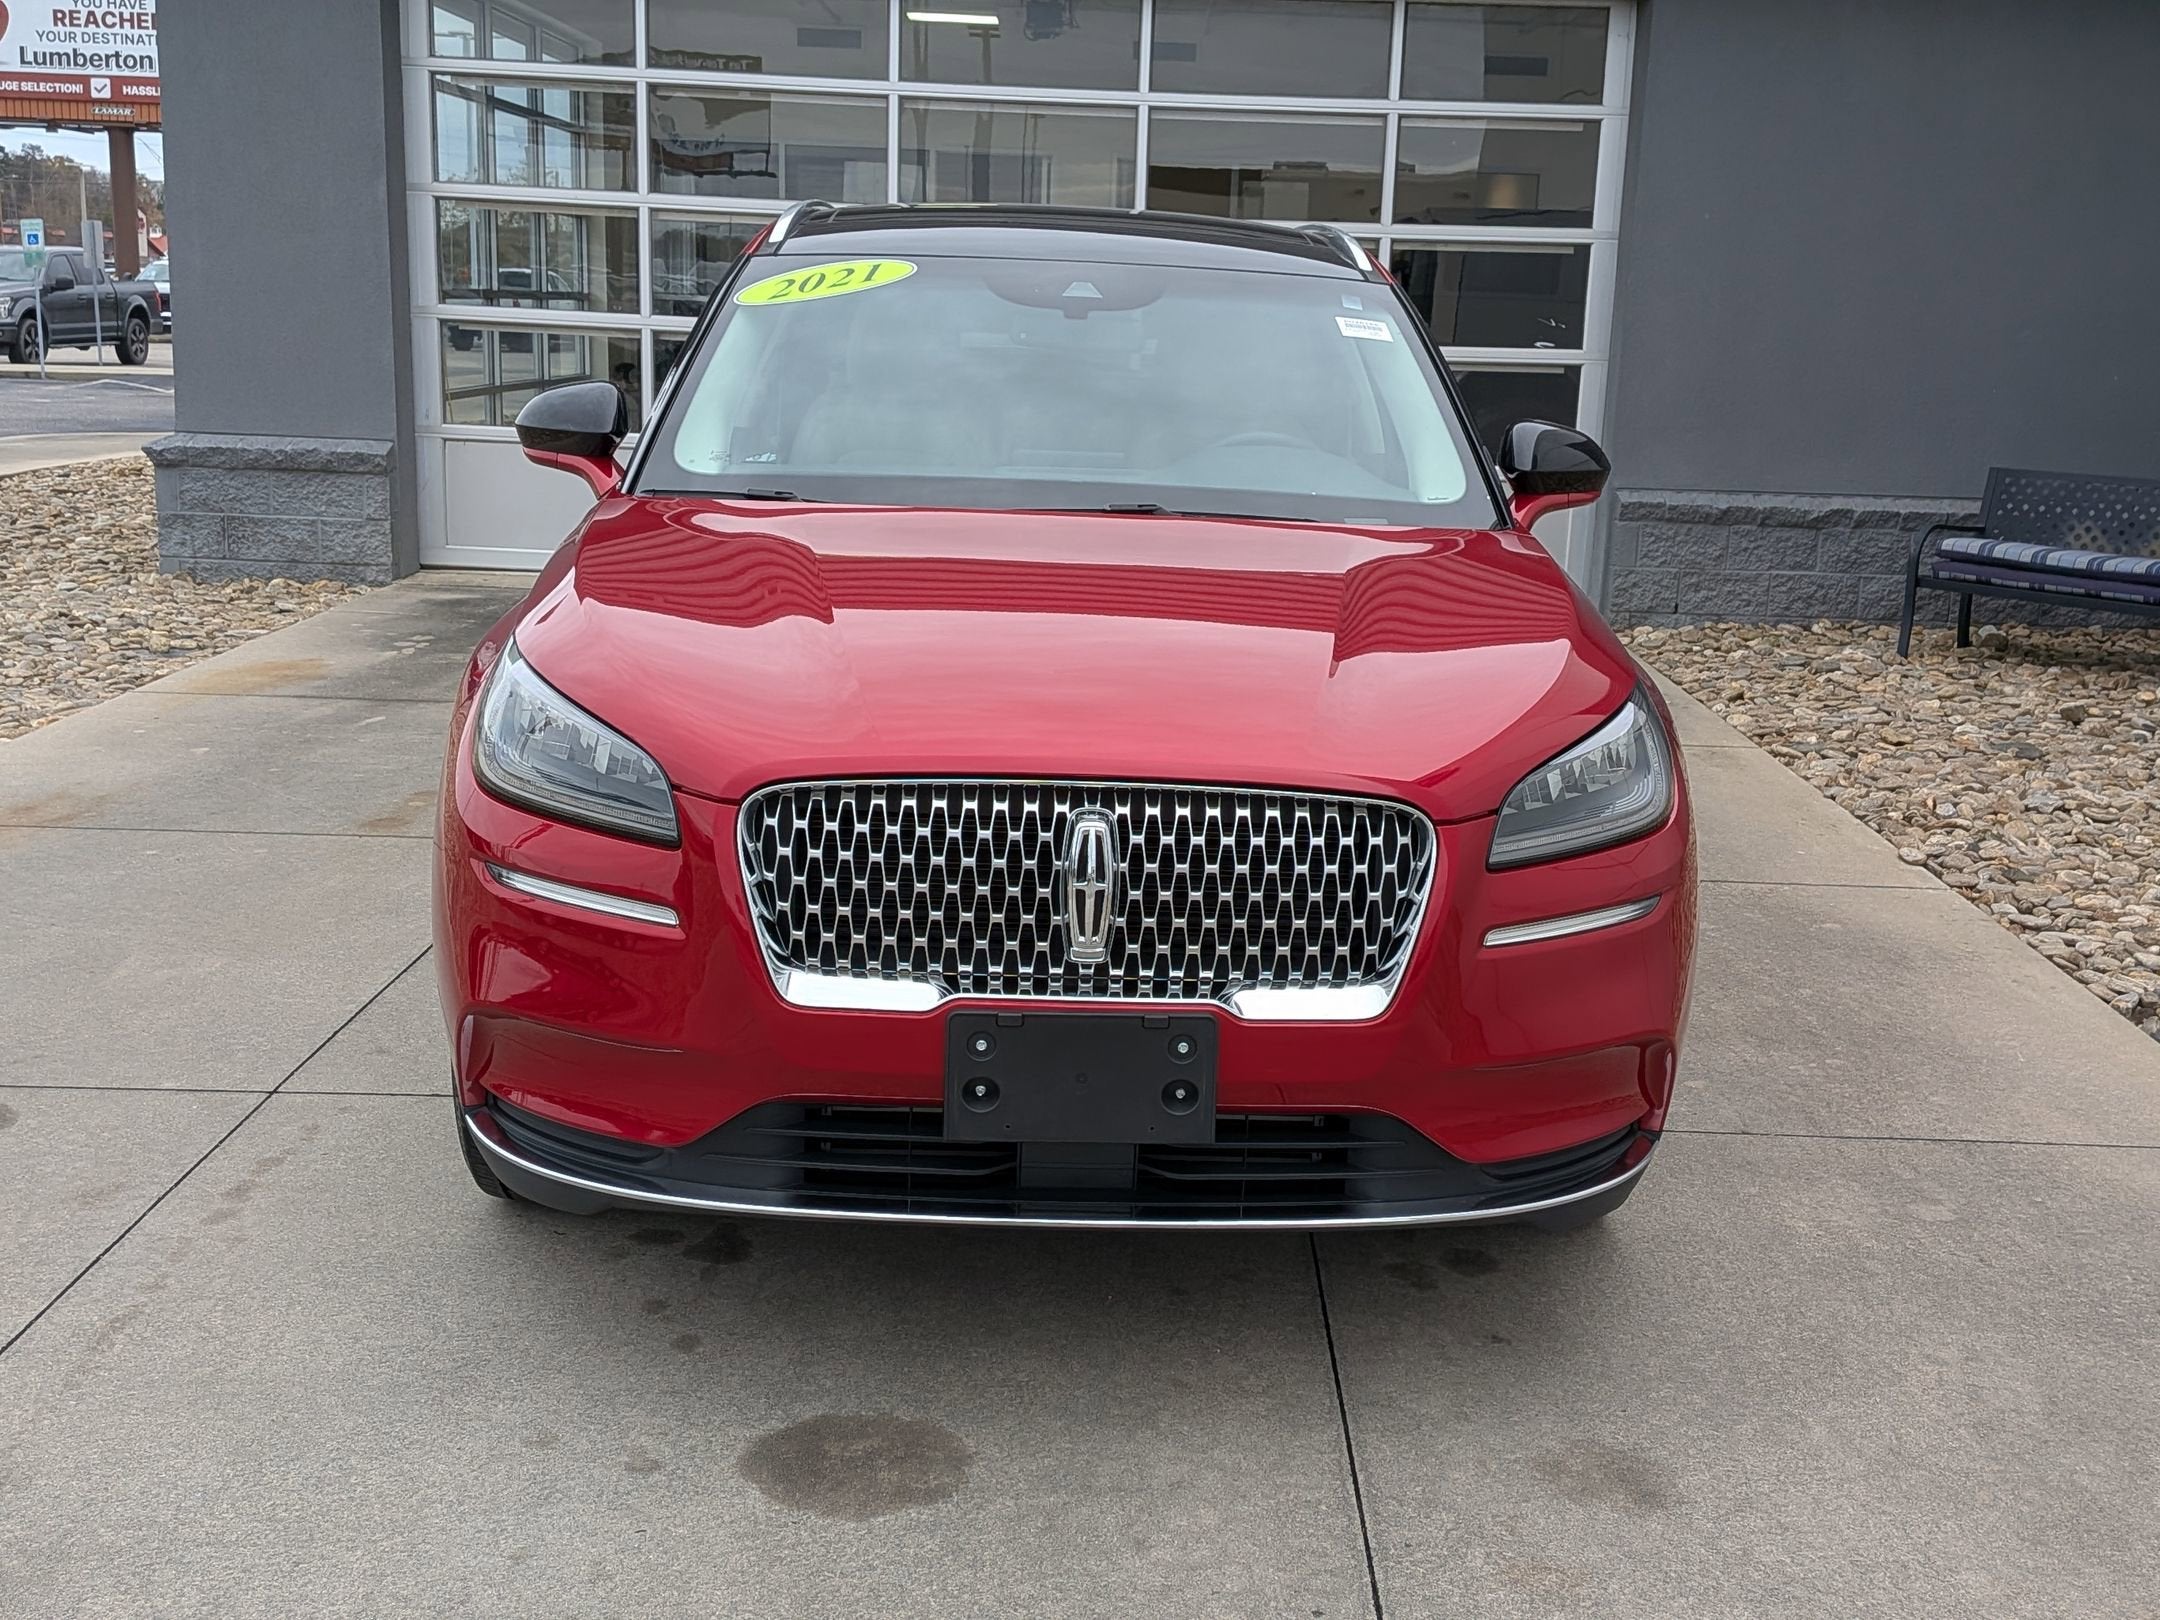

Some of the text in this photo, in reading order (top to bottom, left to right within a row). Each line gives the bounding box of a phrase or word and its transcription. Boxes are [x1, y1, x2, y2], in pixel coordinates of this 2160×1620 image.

[72, 0, 147, 10] YOU HAVE
[35, 30, 77, 43] YOUR
[19, 46, 155, 71] Lumberton
[20, 81, 84, 94] SELECTION!
[94, 106, 132, 116] LAMAR
[767, 263, 882, 301] 2021
